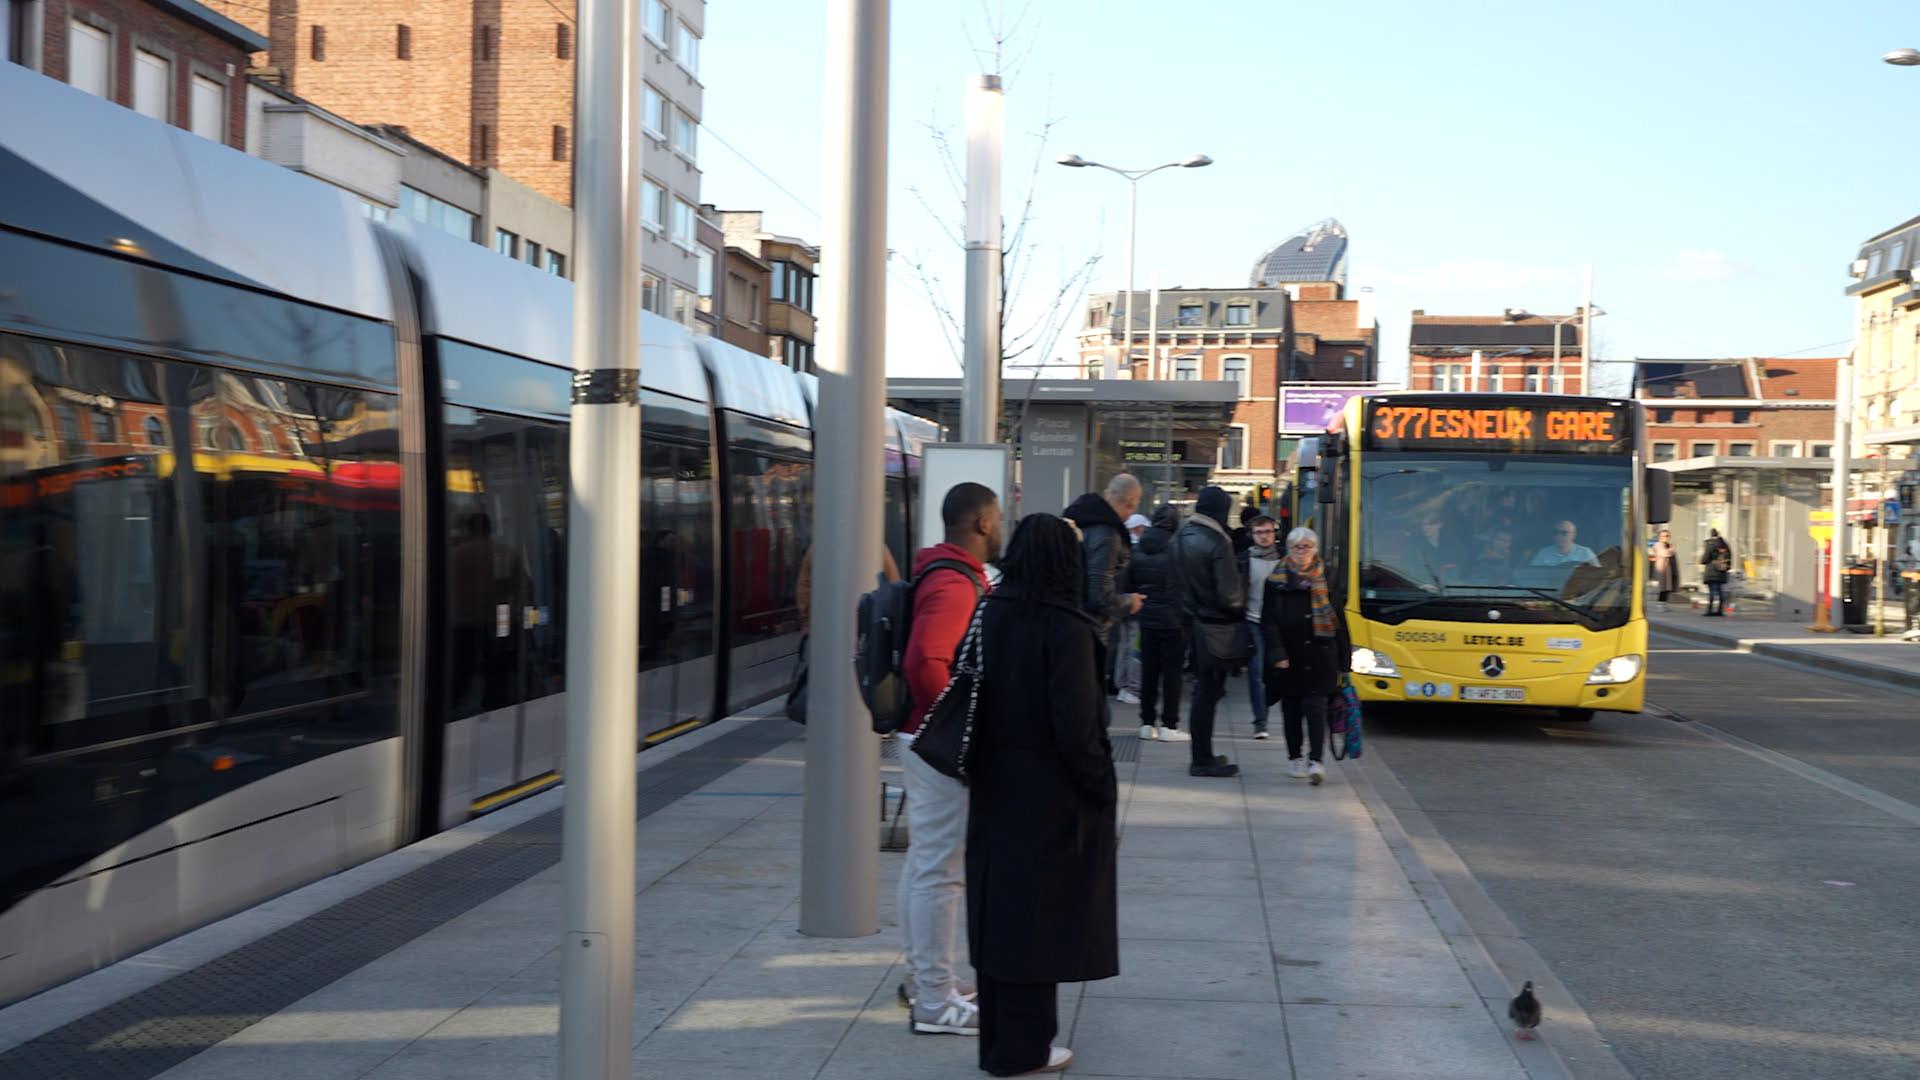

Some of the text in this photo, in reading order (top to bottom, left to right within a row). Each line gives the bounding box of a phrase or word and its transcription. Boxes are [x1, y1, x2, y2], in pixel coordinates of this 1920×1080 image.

[1375, 406, 1615, 441] 377 ESNEUX GARE
[1463, 634, 1525, 647] LETEC.BE
